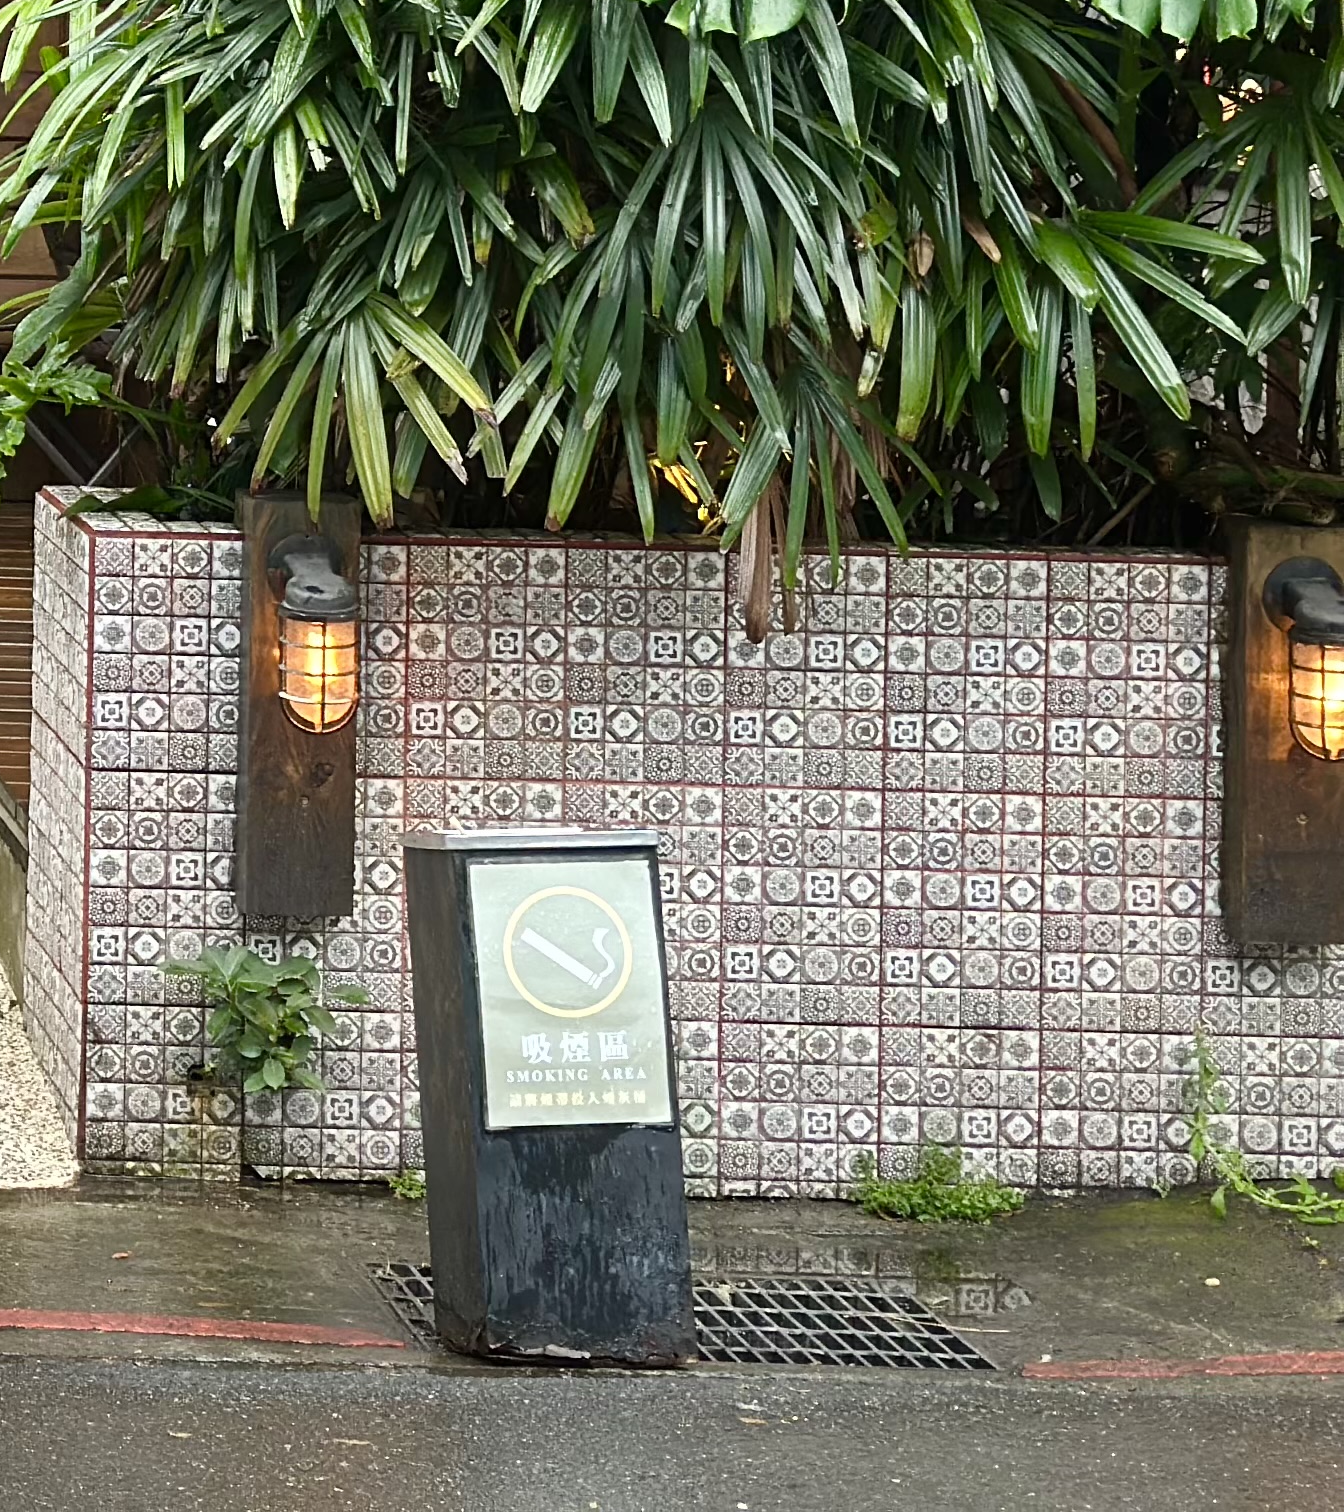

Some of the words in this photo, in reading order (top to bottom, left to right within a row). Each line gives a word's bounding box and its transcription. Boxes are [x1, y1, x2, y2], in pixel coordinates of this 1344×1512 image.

[521, 1030, 629, 1064] 吸煙區
[506, 1069, 589, 1083] SMOKING
[600, 1067, 647, 1081] AREA
